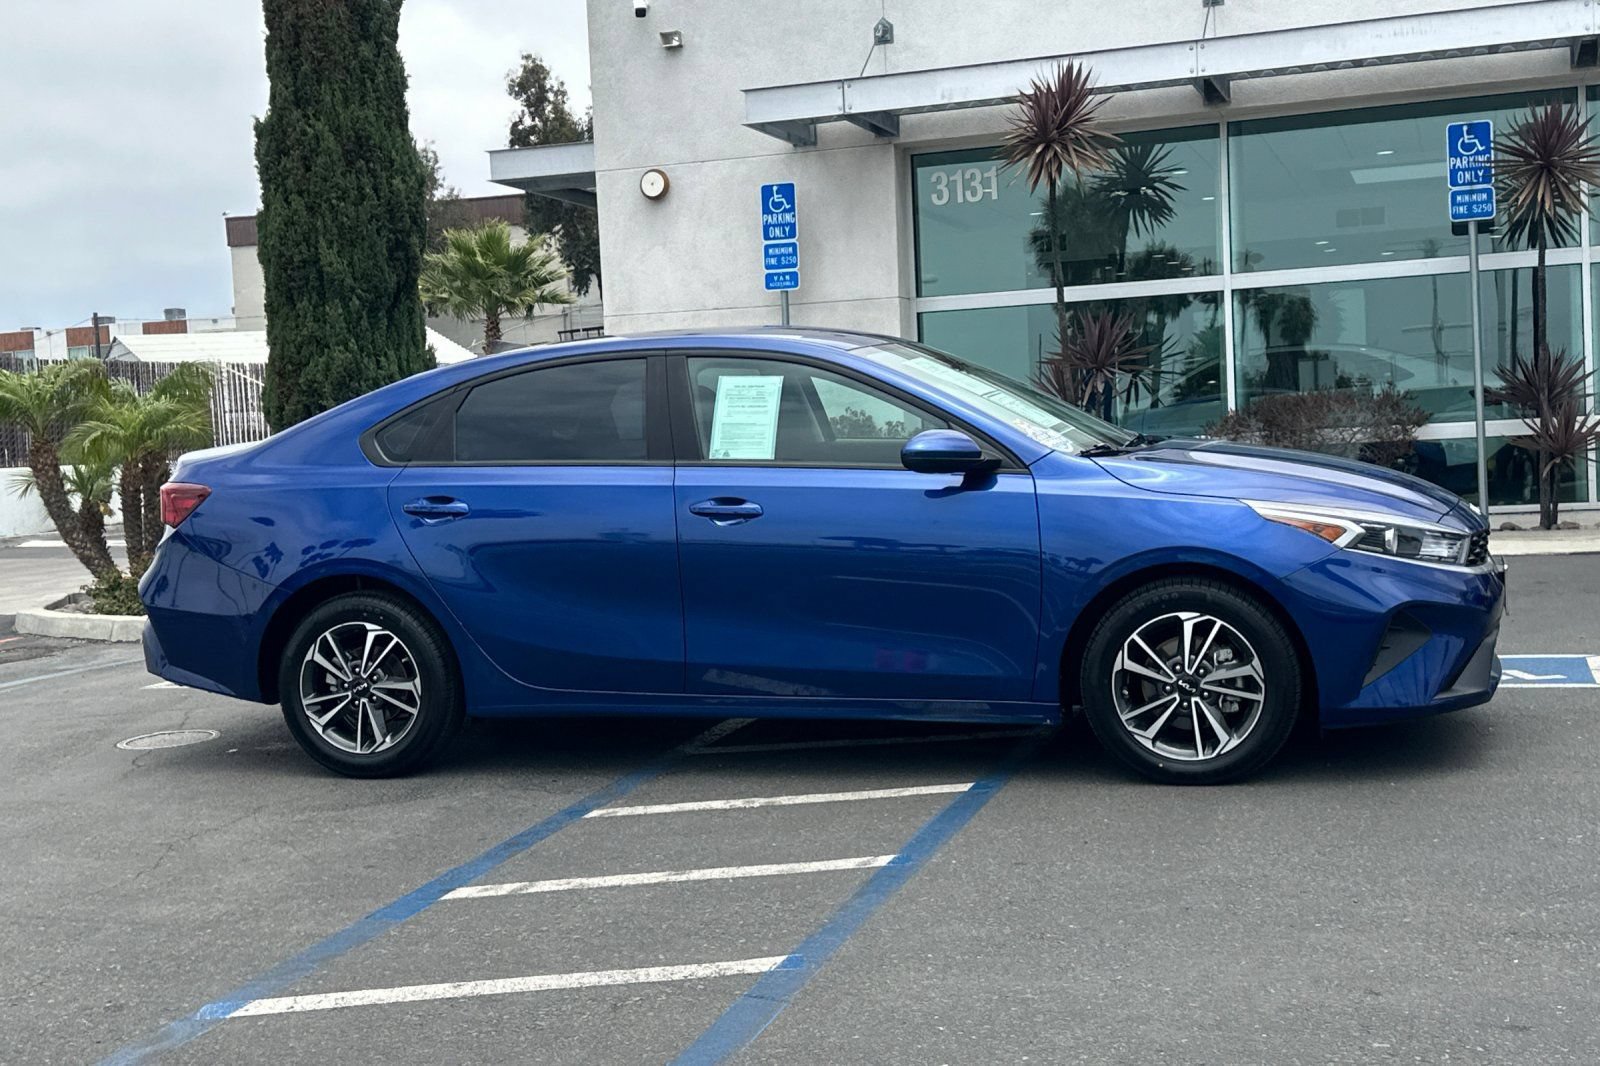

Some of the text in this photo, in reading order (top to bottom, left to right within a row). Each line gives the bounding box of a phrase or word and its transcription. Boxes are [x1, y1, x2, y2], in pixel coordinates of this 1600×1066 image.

[1450, 154, 1490, 169] PARKING
[1457, 170, 1484, 184] ONLY
[930, 166, 998, 206] 3131
[1456, 193, 1487, 203] MINIMUM
[1452, 204, 1492, 214] FINE $250
[763, 212, 796, 225] PARKING
[769, 226, 790, 238] ONLY
[768, 247, 793, 255] MINIMUM
[765, 256, 797, 265] FINE $250
